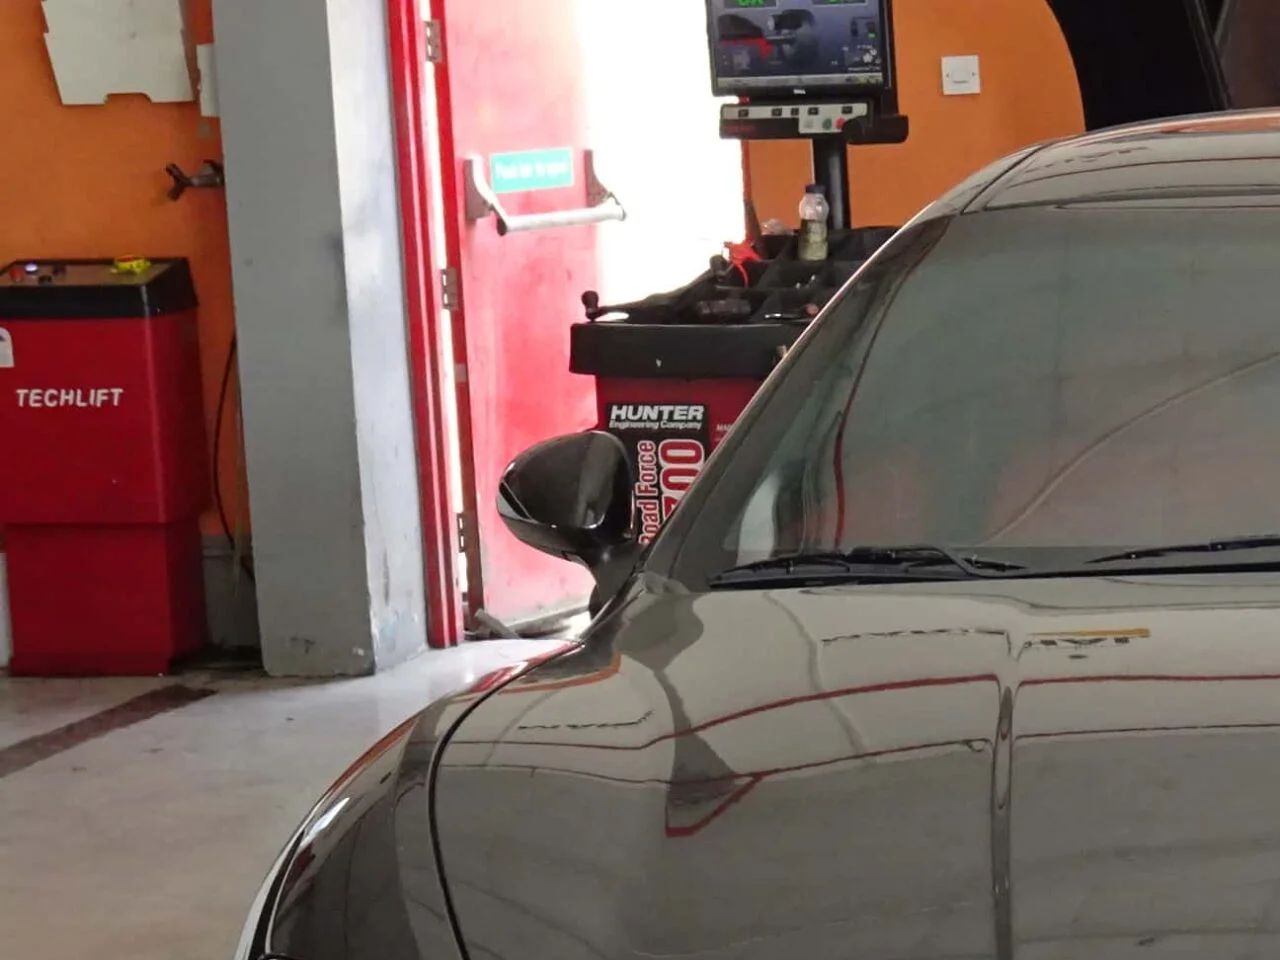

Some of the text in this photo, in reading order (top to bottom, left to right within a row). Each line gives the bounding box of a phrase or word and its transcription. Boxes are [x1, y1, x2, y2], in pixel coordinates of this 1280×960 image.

[16, 388, 123, 407] TECHLIFT
[610, 404, 704, 420] HUNTER
[609, 419, 702, 430] Engineering Company
[635, 440, 658, 496] Force
